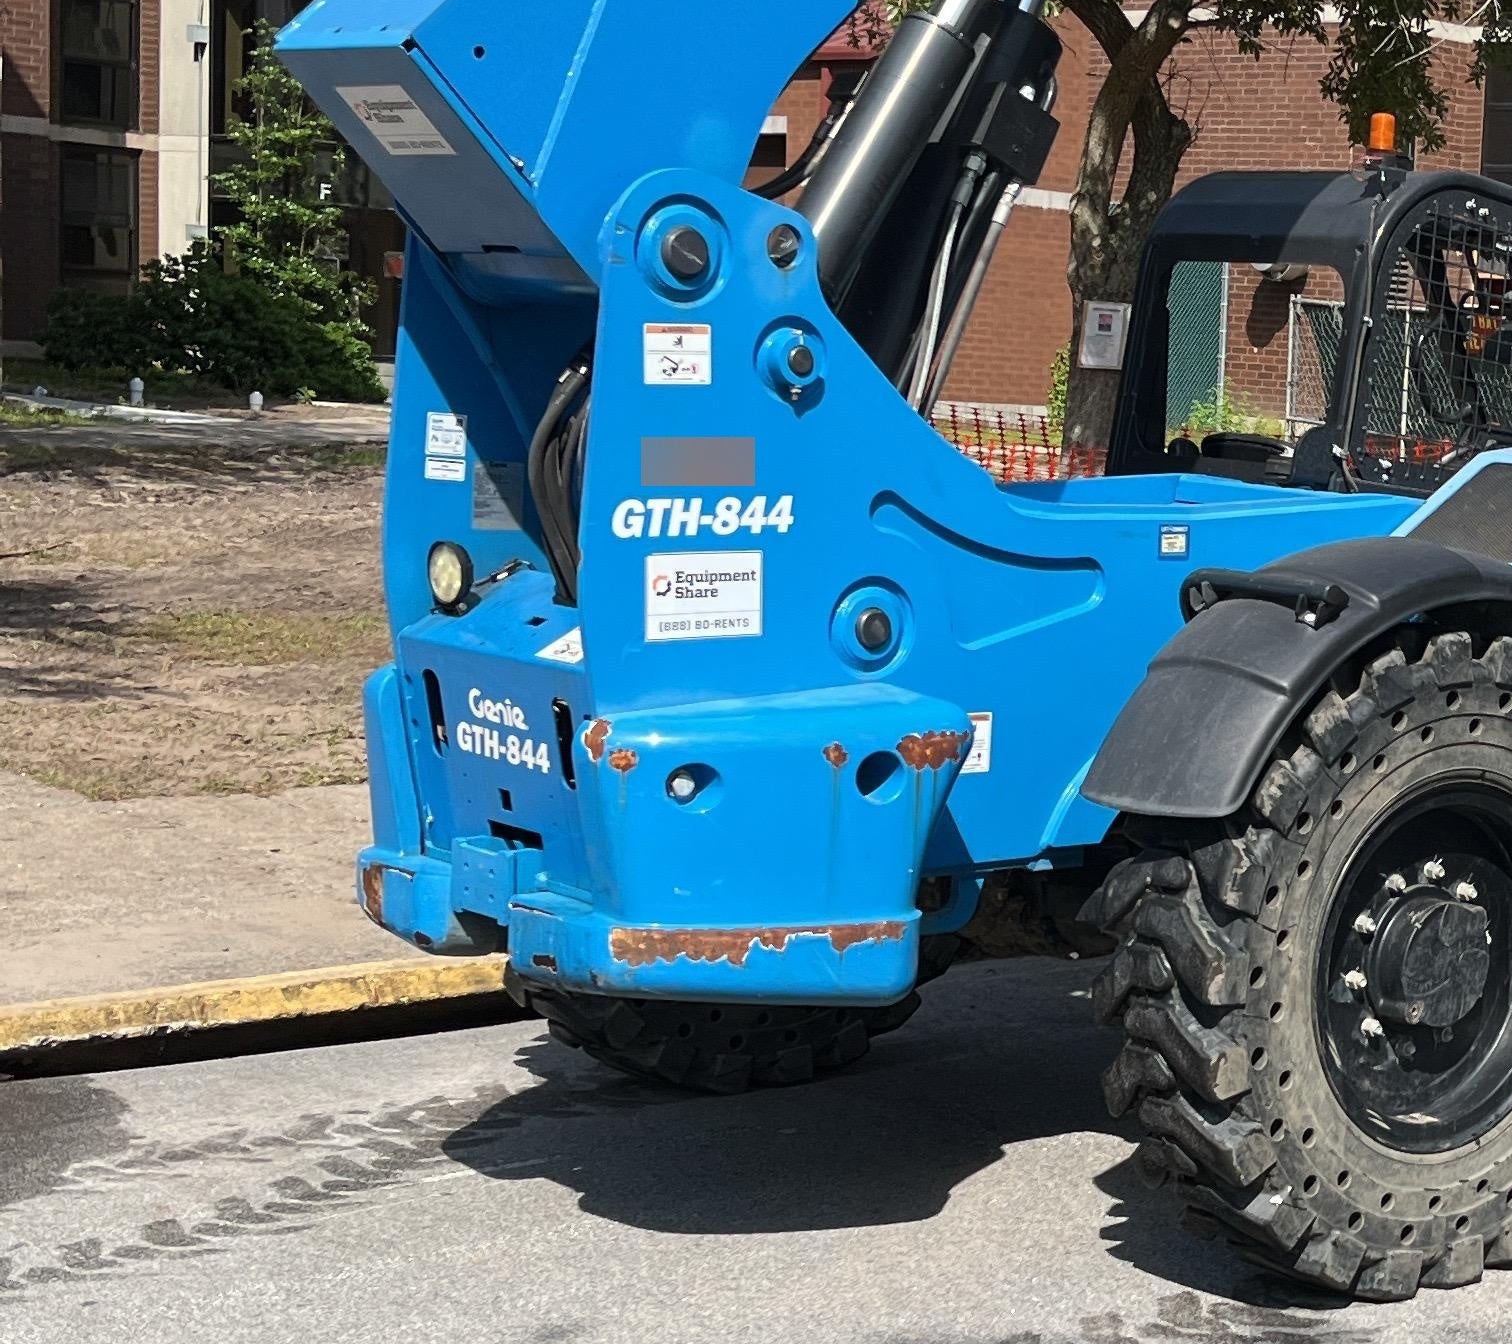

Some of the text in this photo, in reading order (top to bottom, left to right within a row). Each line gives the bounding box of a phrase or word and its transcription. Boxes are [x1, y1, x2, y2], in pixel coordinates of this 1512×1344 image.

[320, 182, 332, 200] F
[611, 494, 795, 539] GTH-844
[675, 570, 757, 586] Equipment
[675, 586, 719, 599] Share
[468, 687, 530, 731] Genie
[456, 721, 551, 774] GTH-844
